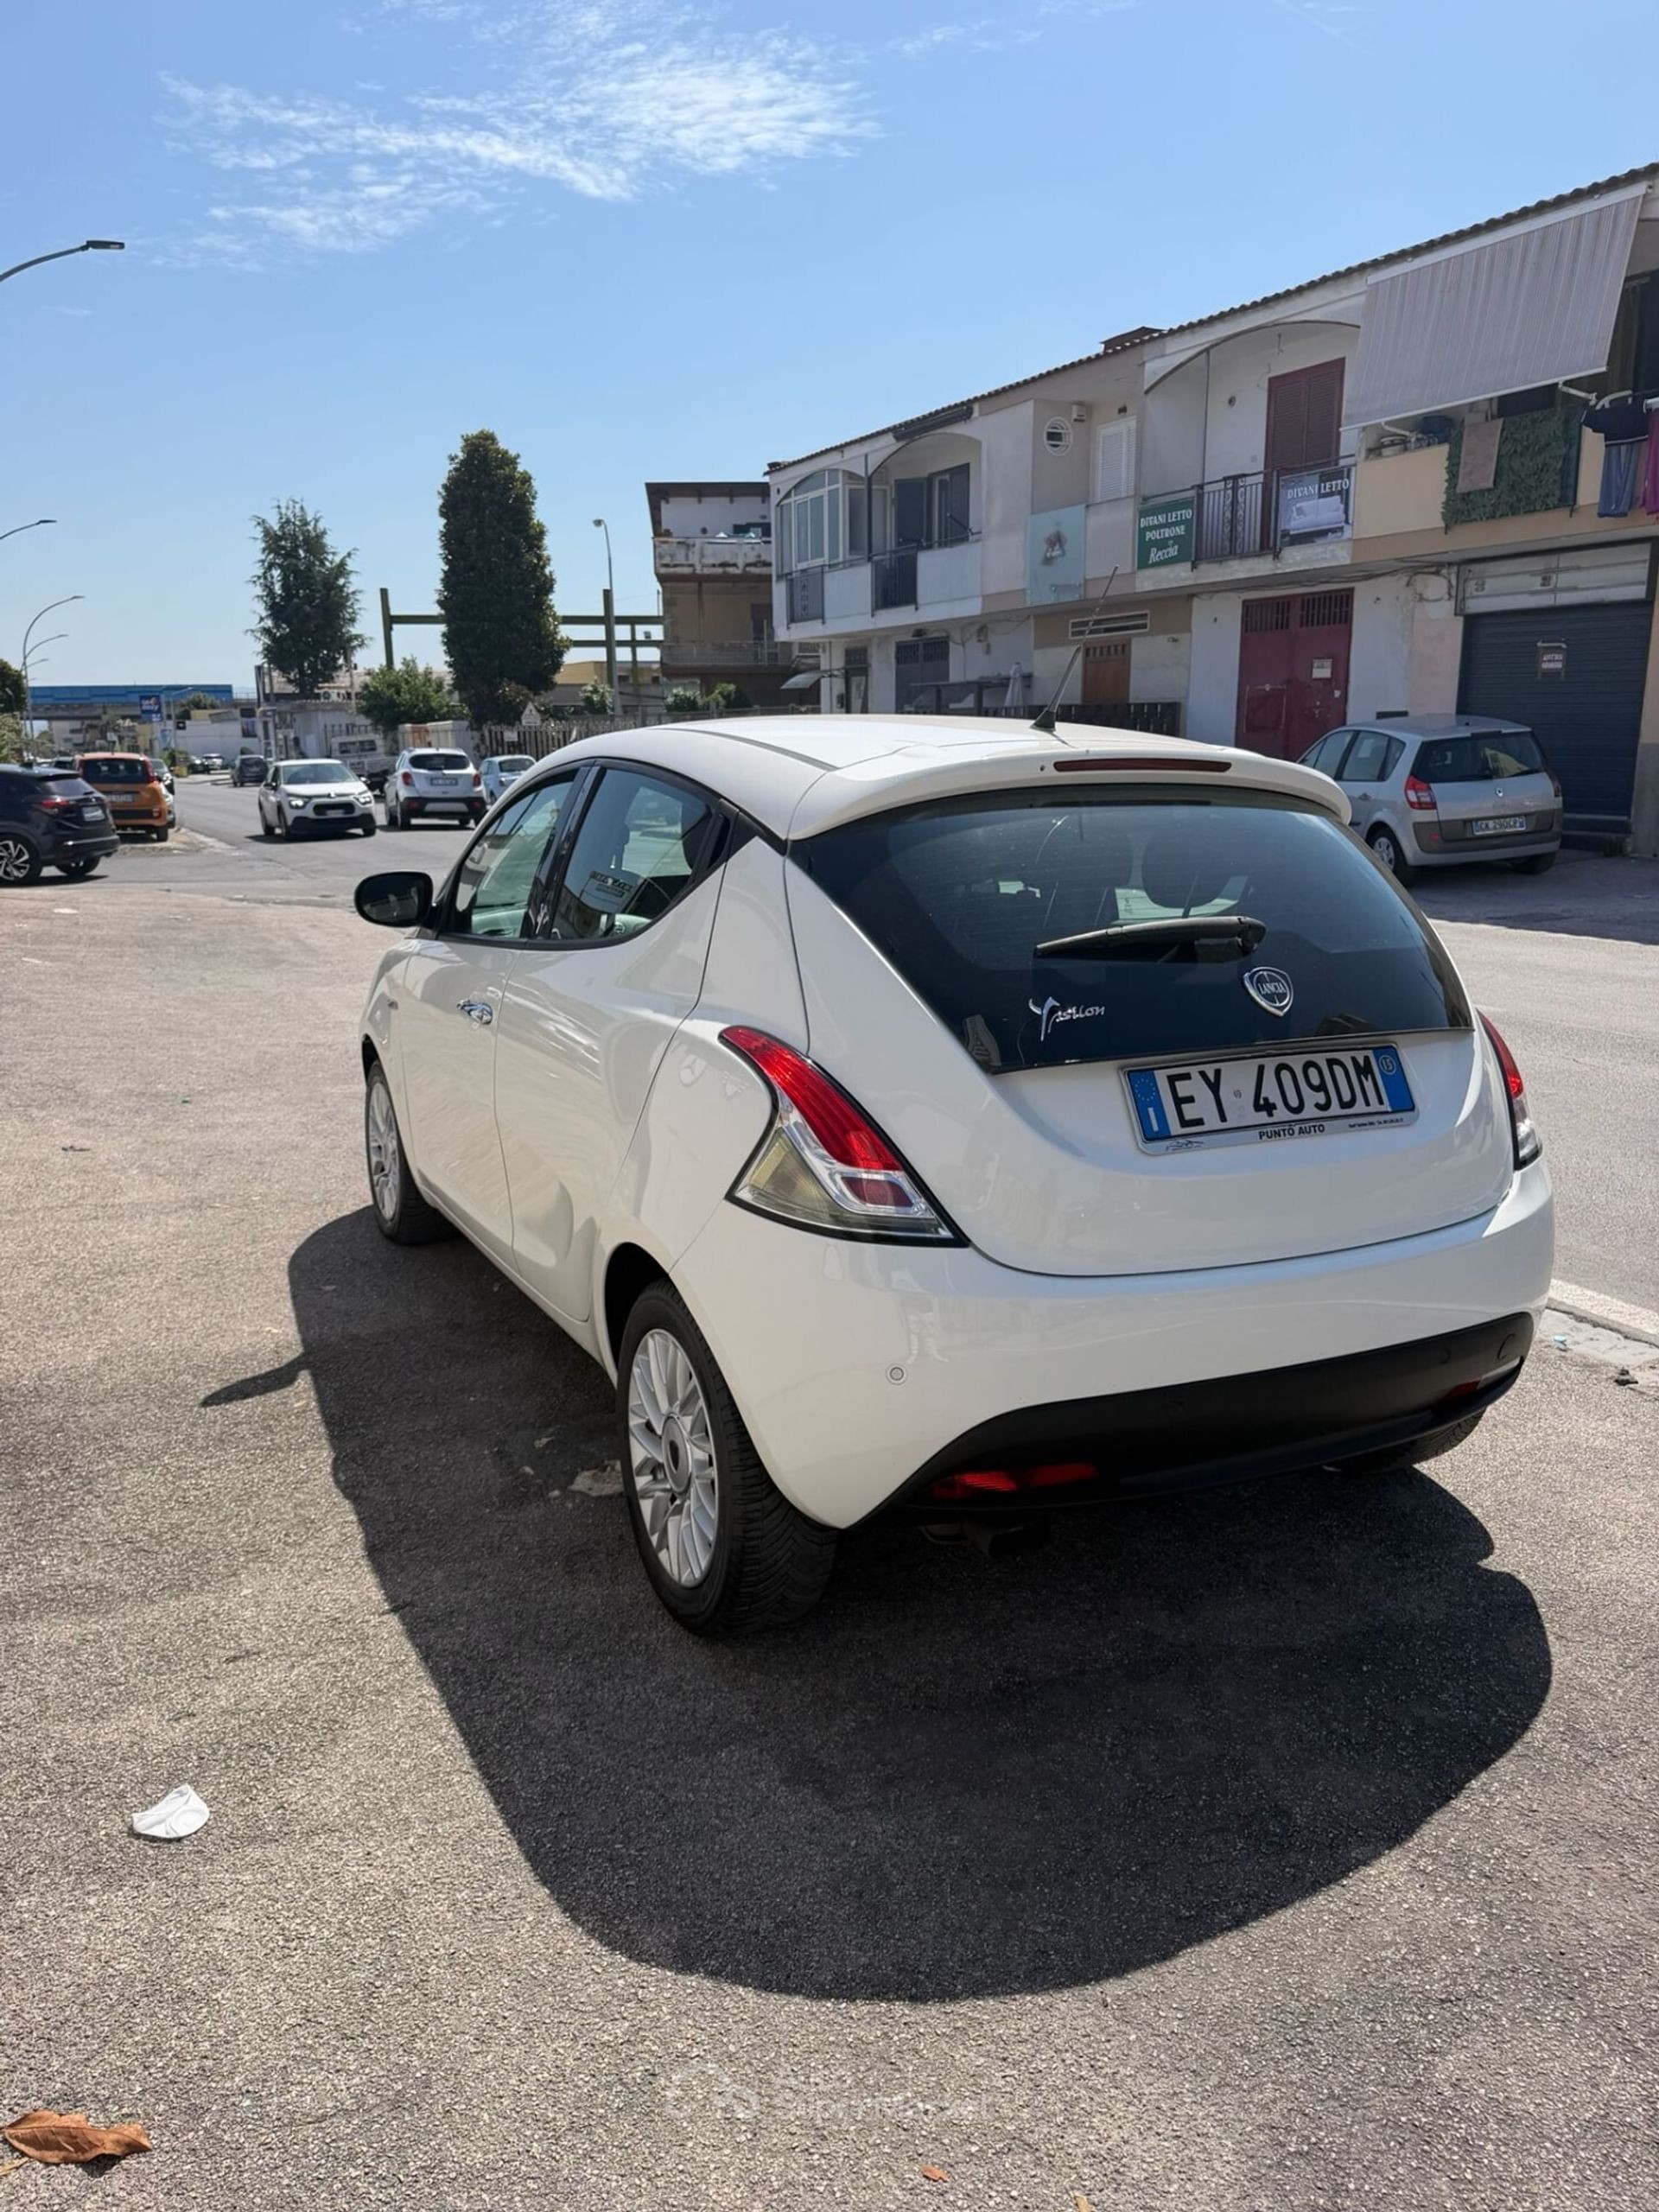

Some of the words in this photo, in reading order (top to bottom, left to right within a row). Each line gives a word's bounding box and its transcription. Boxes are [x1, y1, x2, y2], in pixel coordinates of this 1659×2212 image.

[1287, 485, 1318, 499] DIVANI
[1320, 478, 1350, 494] LETTO
[1140, 514, 1166, 527] DIVANI
[1167, 508, 1192, 523] LETTO
[1146, 524, 1185, 541] POLTRONE
[1148, 544, 1178, 563] Reccia
[1258, 982, 1288, 995] LANCIA
[1167, 1069, 1227, 1128] EY
[1253, 1055, 1384, 1118] 409DM
[1258, 1125, 1295, 1140] PUNTO
[1298, 1124, 1325, 1136] AUTO
